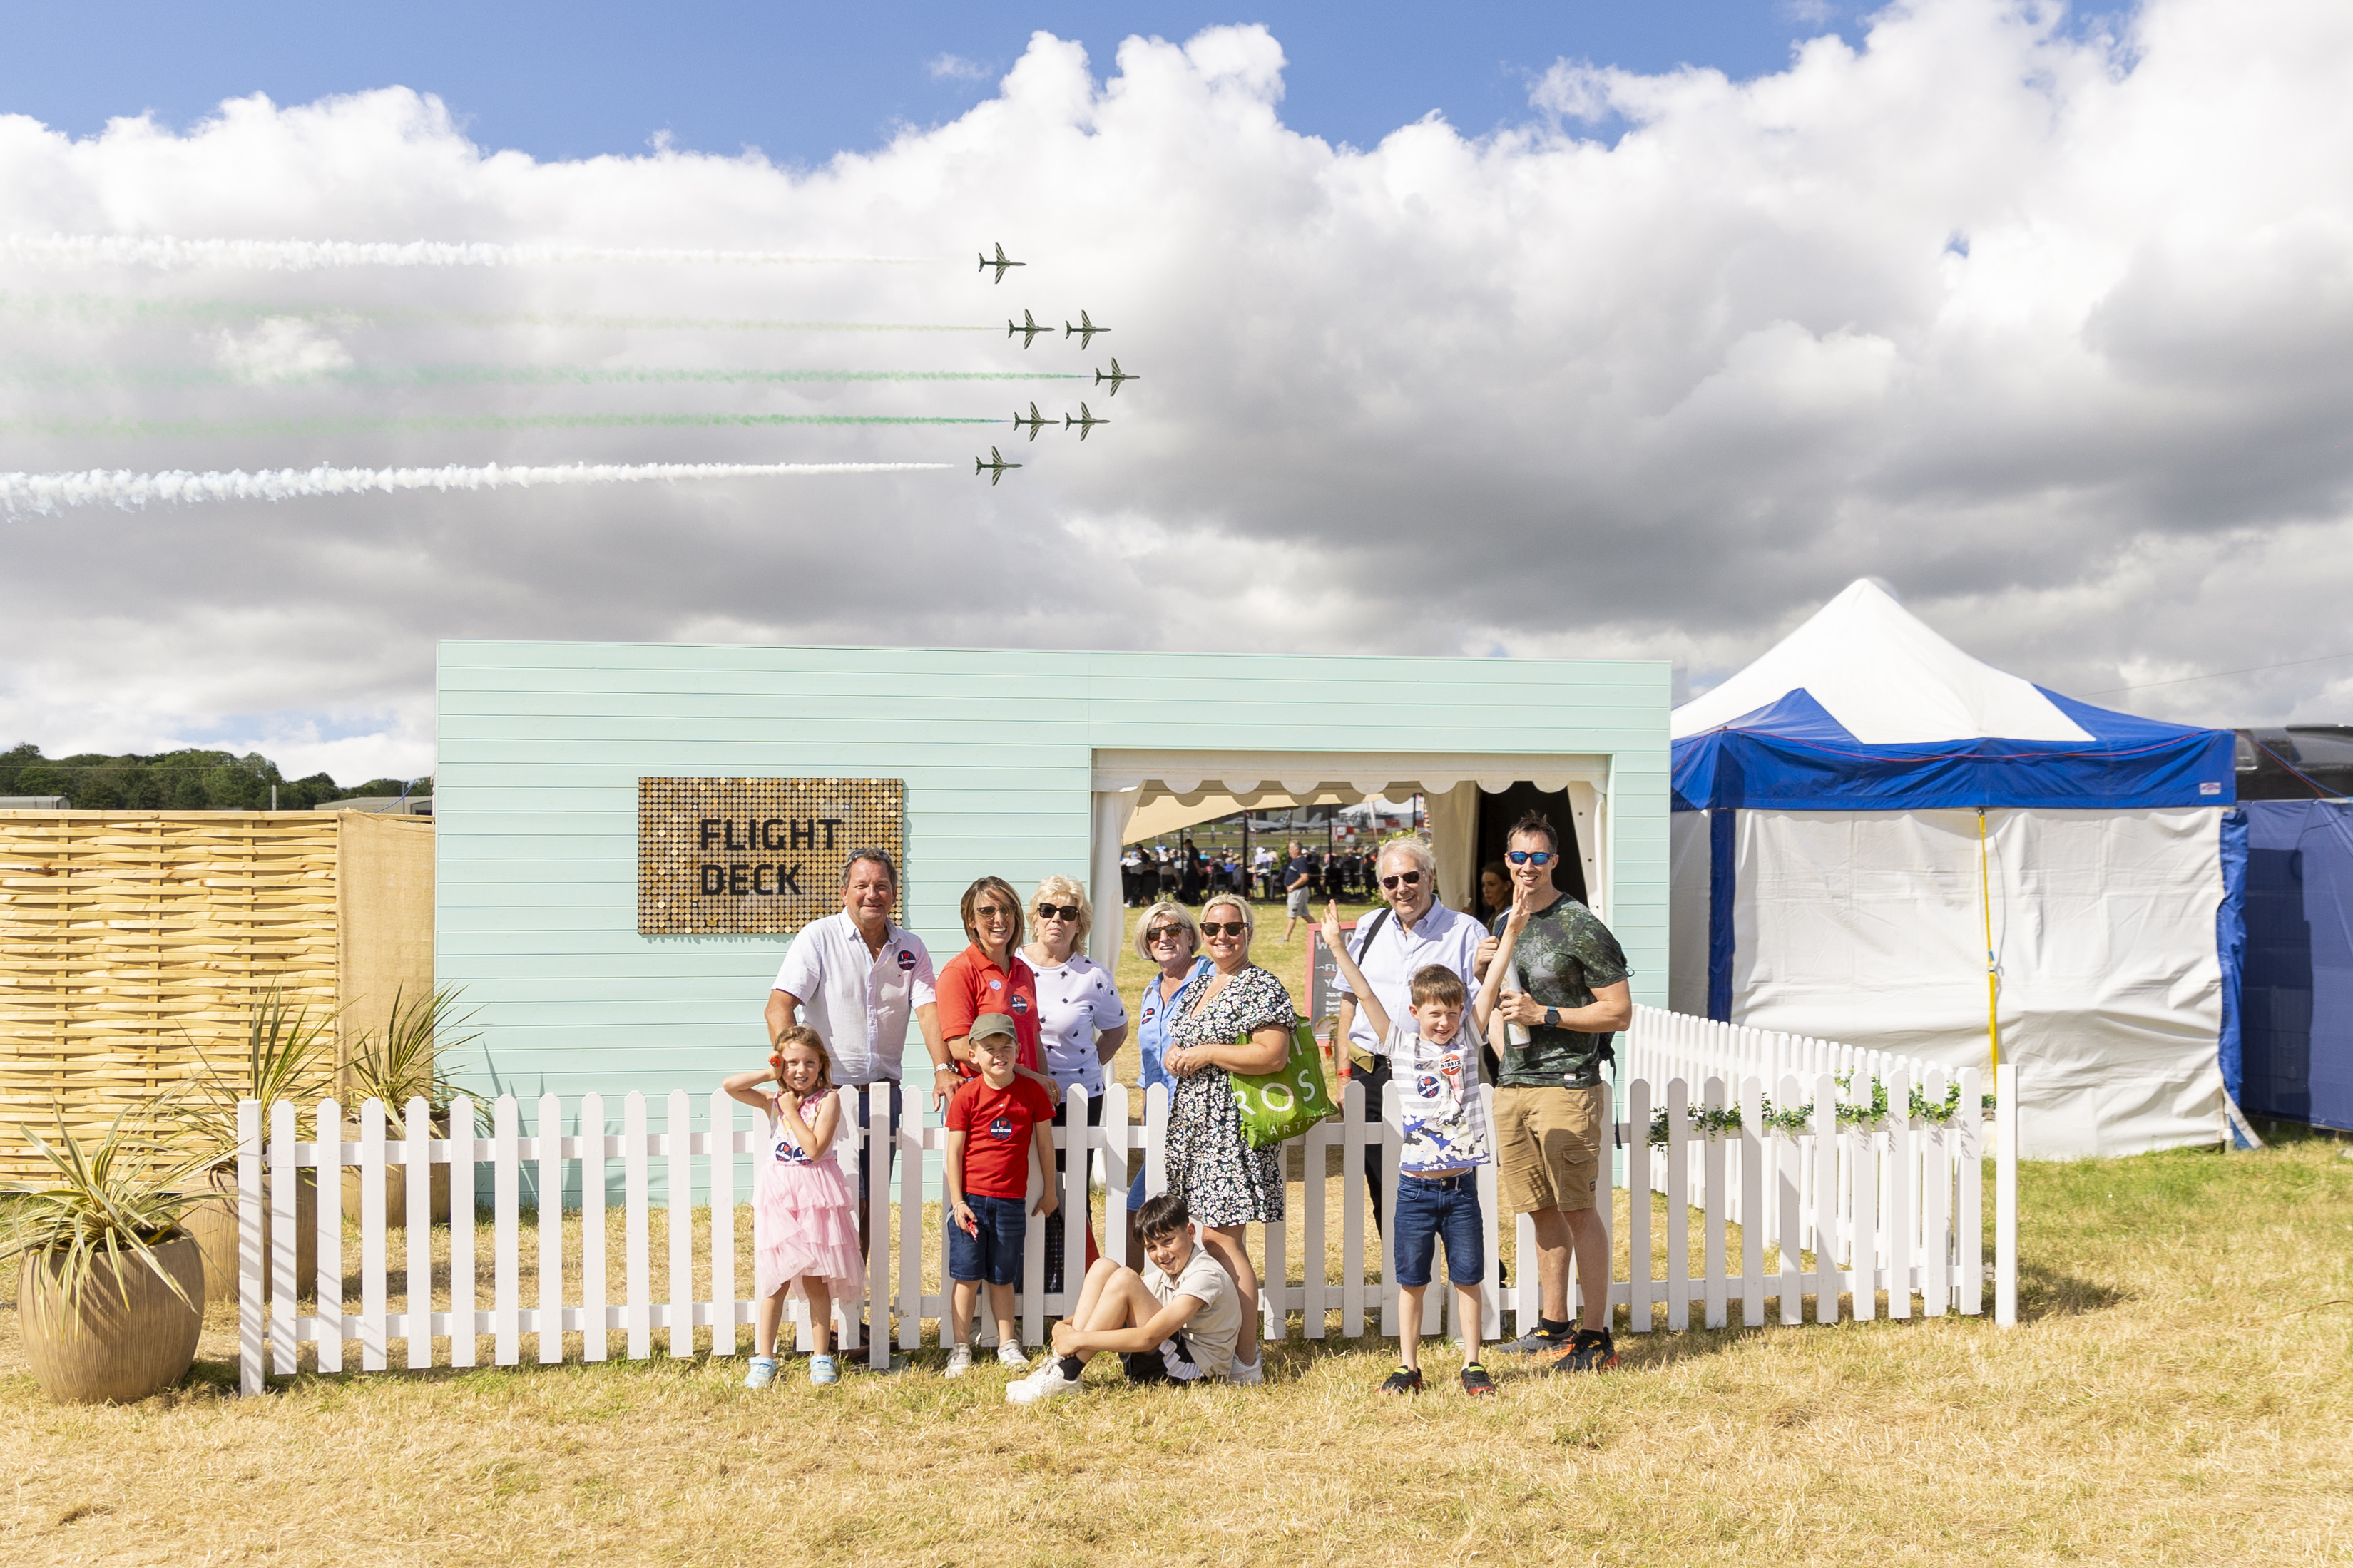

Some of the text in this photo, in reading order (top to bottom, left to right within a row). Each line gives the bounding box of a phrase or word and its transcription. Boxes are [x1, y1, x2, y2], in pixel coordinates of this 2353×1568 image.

[701, 819, 842, 850] FLIGHT
[701, 864, 802, 896] DECK
[1441, 1060, 1461, 1068] AIRFIX
[1233, 1062, 1324, 1115] ROS
[1268, 1107, 1335, 1136] ARTNE
